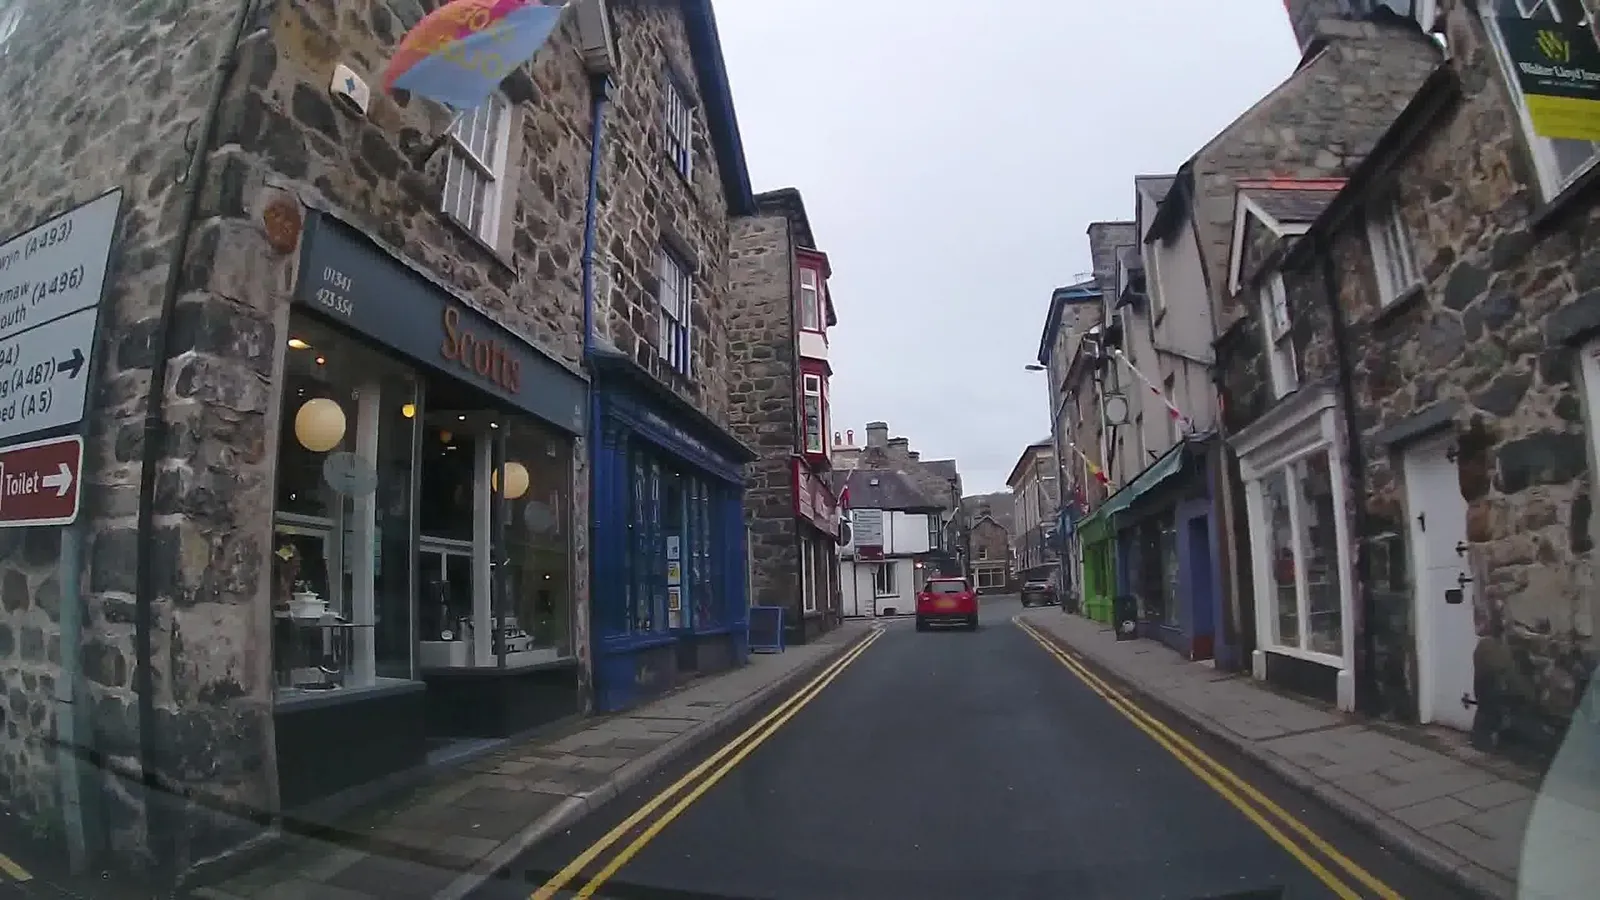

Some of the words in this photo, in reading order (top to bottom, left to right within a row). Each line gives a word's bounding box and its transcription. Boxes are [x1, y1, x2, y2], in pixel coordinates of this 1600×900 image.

[323, 266, 352, 292] 01341
[441, 305, 521, 394] Scotts
[0, 380, 9, 398] g
[0, 399, 16, 421] ed
[6, 470, 39, 496] Toilet
